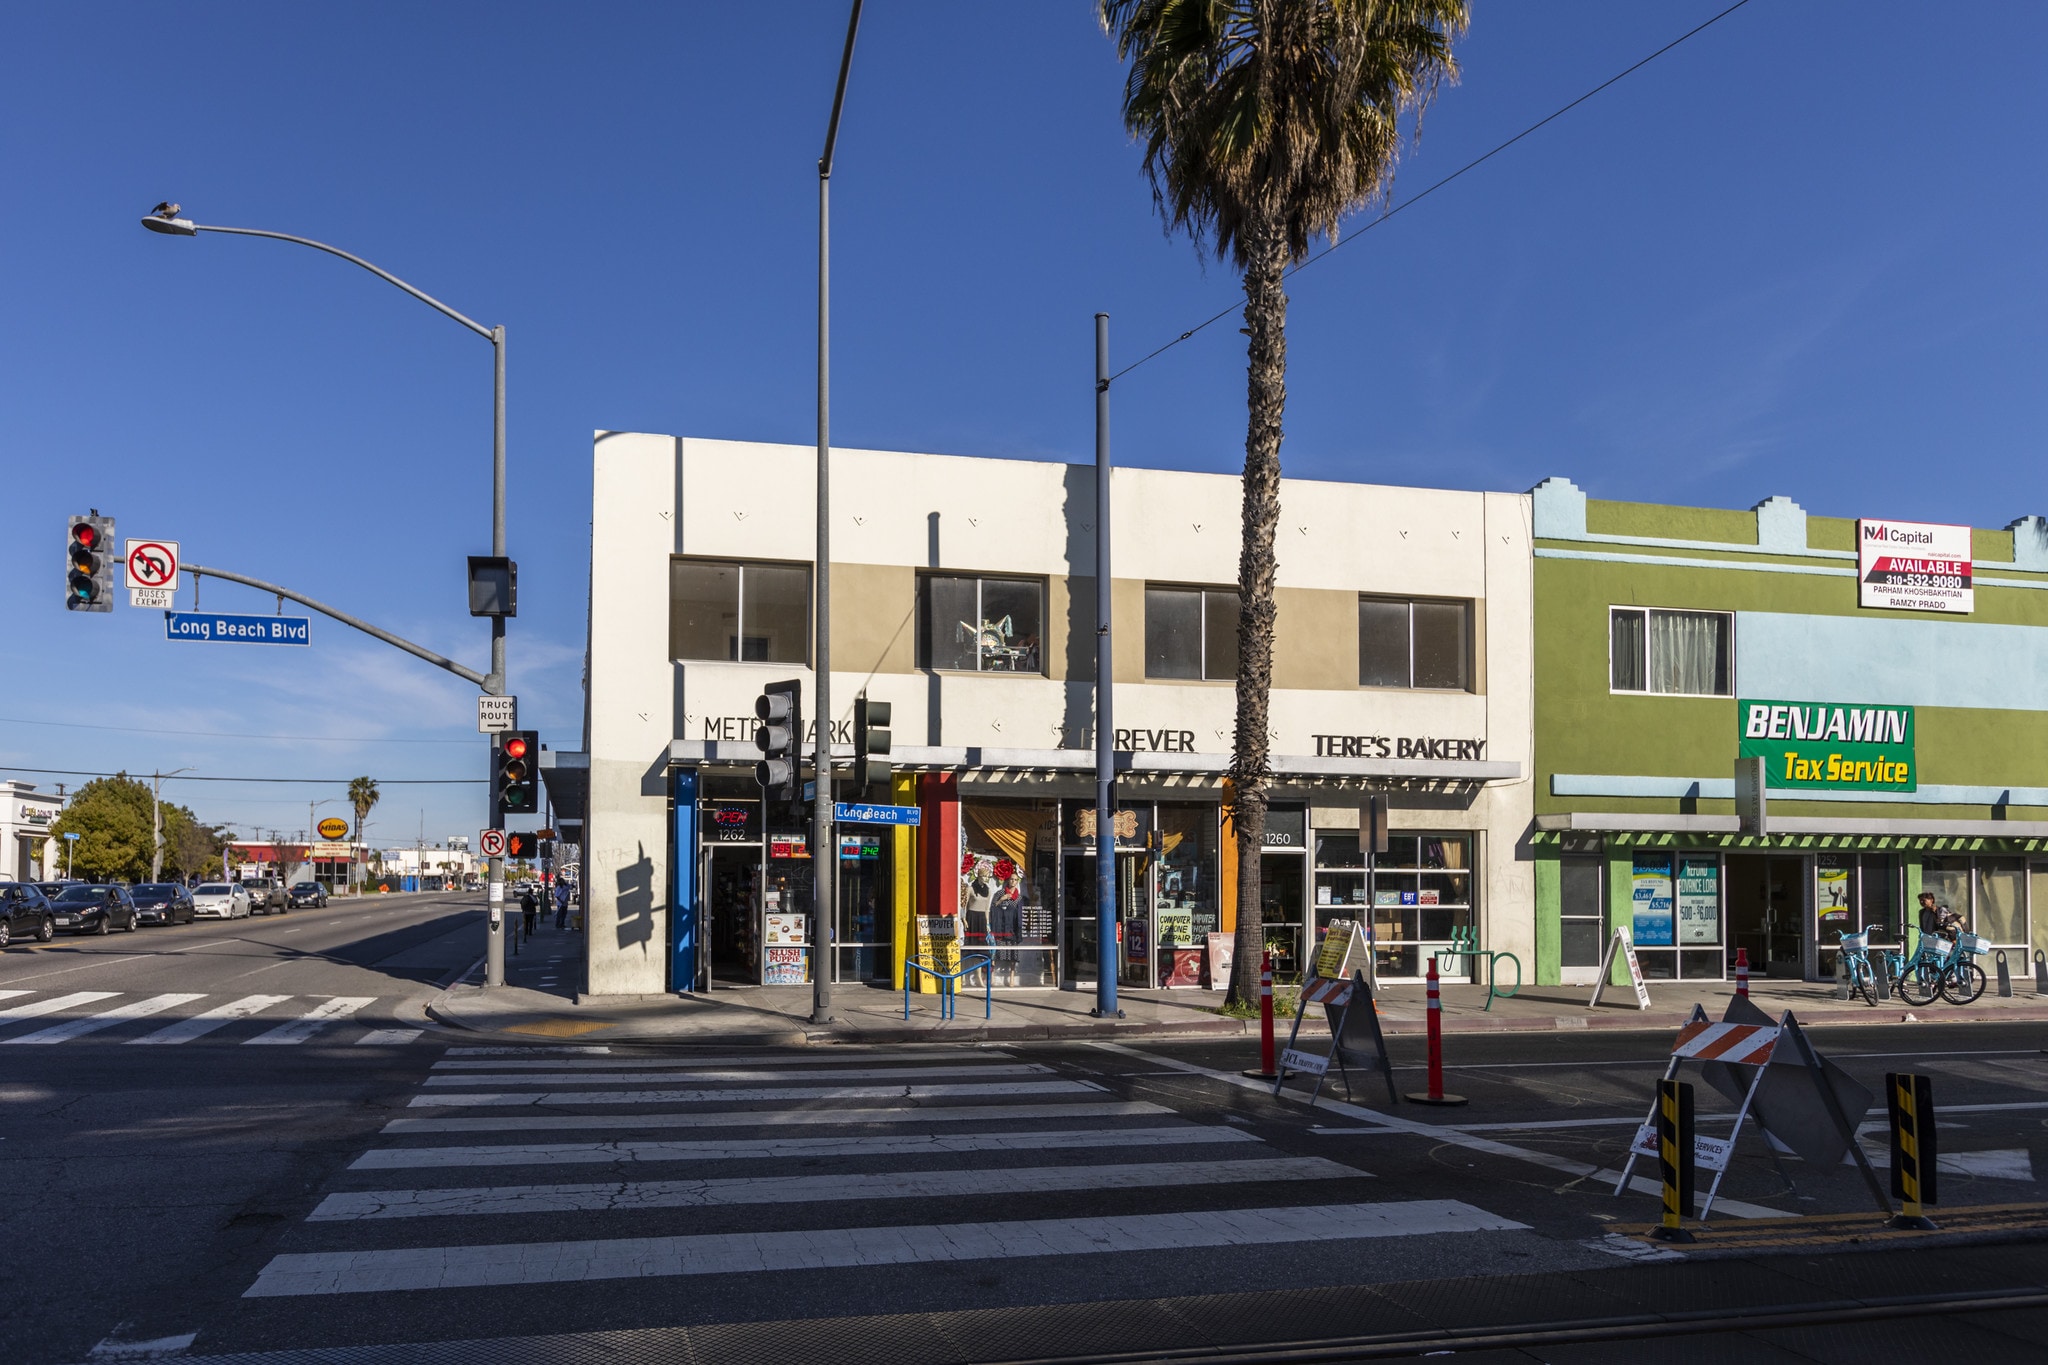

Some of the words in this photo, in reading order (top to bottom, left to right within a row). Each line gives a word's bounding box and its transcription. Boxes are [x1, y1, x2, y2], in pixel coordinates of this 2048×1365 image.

[1864, 524, 1888, 541] NAI
[1890, 530, 1933, 545] Capital
[1889, 559, 1962, 575] AVAILABLE
[1886, 574, 1962, 588] 310-532-9080
[138, 589, 166, 599] BUSES
[1873, 586, 1903, 595] PARHAM
[1904, 587, 1962, 598] KHOSHBAKHTIAN
[135, 598, 168, 608] EXEMPT
[1890, 598, 1916, 607] RAMZY
[1919, 600, 1946, 609] PRADO
[169, 617, 210, 640] Long
[216, 620, 266, 638] Beach
[272, 623, 306, 640] Blvd
[480, 701, 515, 709] TRUCK
[480, 712, 515, 720] ROUTE
[1745, 704, 1908, 744] BENJAMIN
[1311, 734, 1391, 758] TERE'S
[1398, 737, 1487, 761] BAKERY
[1784, 751, 1824, 781] Tax
[1826, 753, 1909, 784] Service
[715, 811, 749, 823] OPEN
[837, 806, 862, 821] Long
[867, 807, 898, 820] Beach
[320, 822, 346, 832] MIDAS
[718, 829, 746, 841] 1262
[1265, 833, 1291, 845] 1260
[772, 844, 791, 853] 495
[797, 844, 805, 853] 2
[843, 846, 860, 855] 173
[861, 847, 879, 856] 342
[1818, 855, 1838, 866] 1252
[1686, 863, 1708, 877] REFUND
[1679, 878, 1702, 893] ADVANCE
[1703, 879, 1717, 893] LOAN
[1403, 892, 1415, 901] EBT
[1160, 915, 1191, 924] COMPUTER
[1164, 925, 1188, 934] PHONE
[1162, 934, 1191, 942] REPAIR
[769, 948, 801, 957] SLUSH
[769, 955, 801, 963] PUPPIE
[1695, 1141, 1723, 1154] SERVICES
